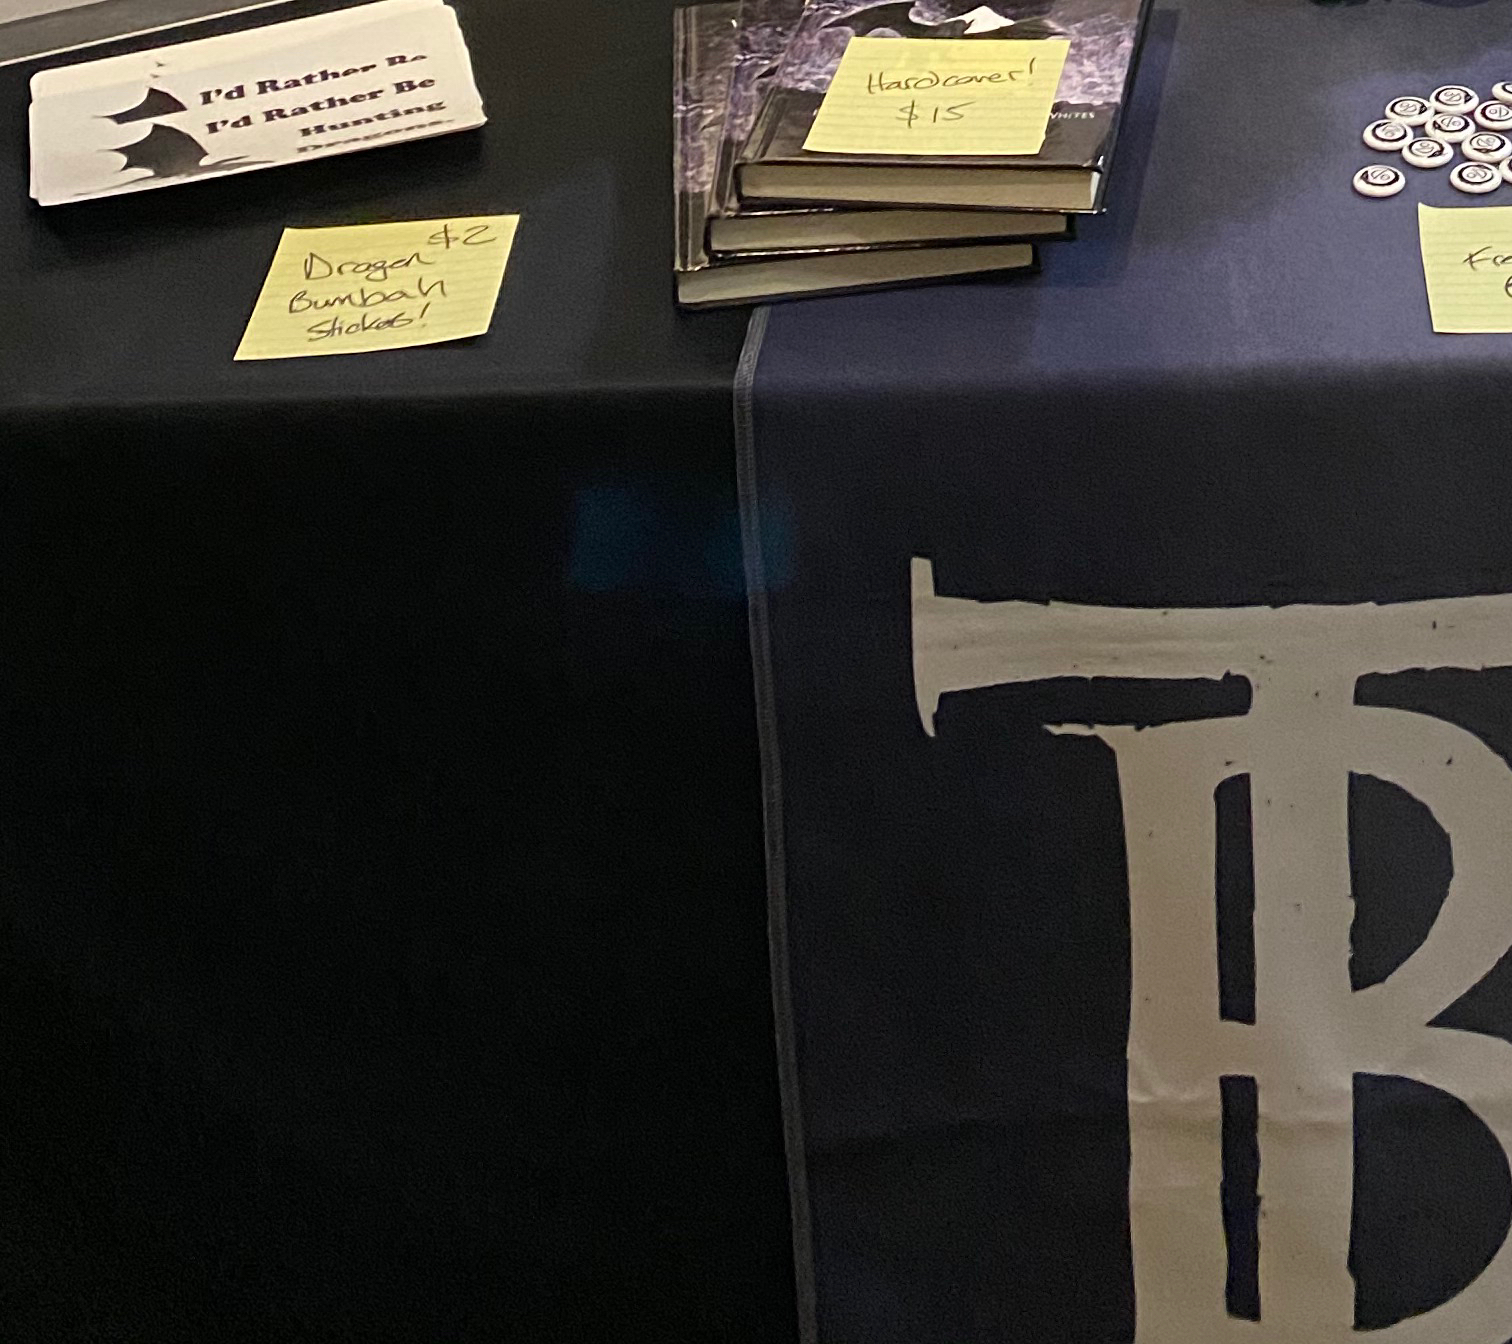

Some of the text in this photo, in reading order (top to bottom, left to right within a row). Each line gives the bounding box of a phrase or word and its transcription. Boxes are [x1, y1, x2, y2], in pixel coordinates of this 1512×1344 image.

[867, 56, 1037, 95] Hardcover!
[200, 84, 245, 106] I'd
[206, 77, 436, 134] I'd Rather Be
[299, 99, 447, 137] Hunting
[427, 223, 497, 249] $2
